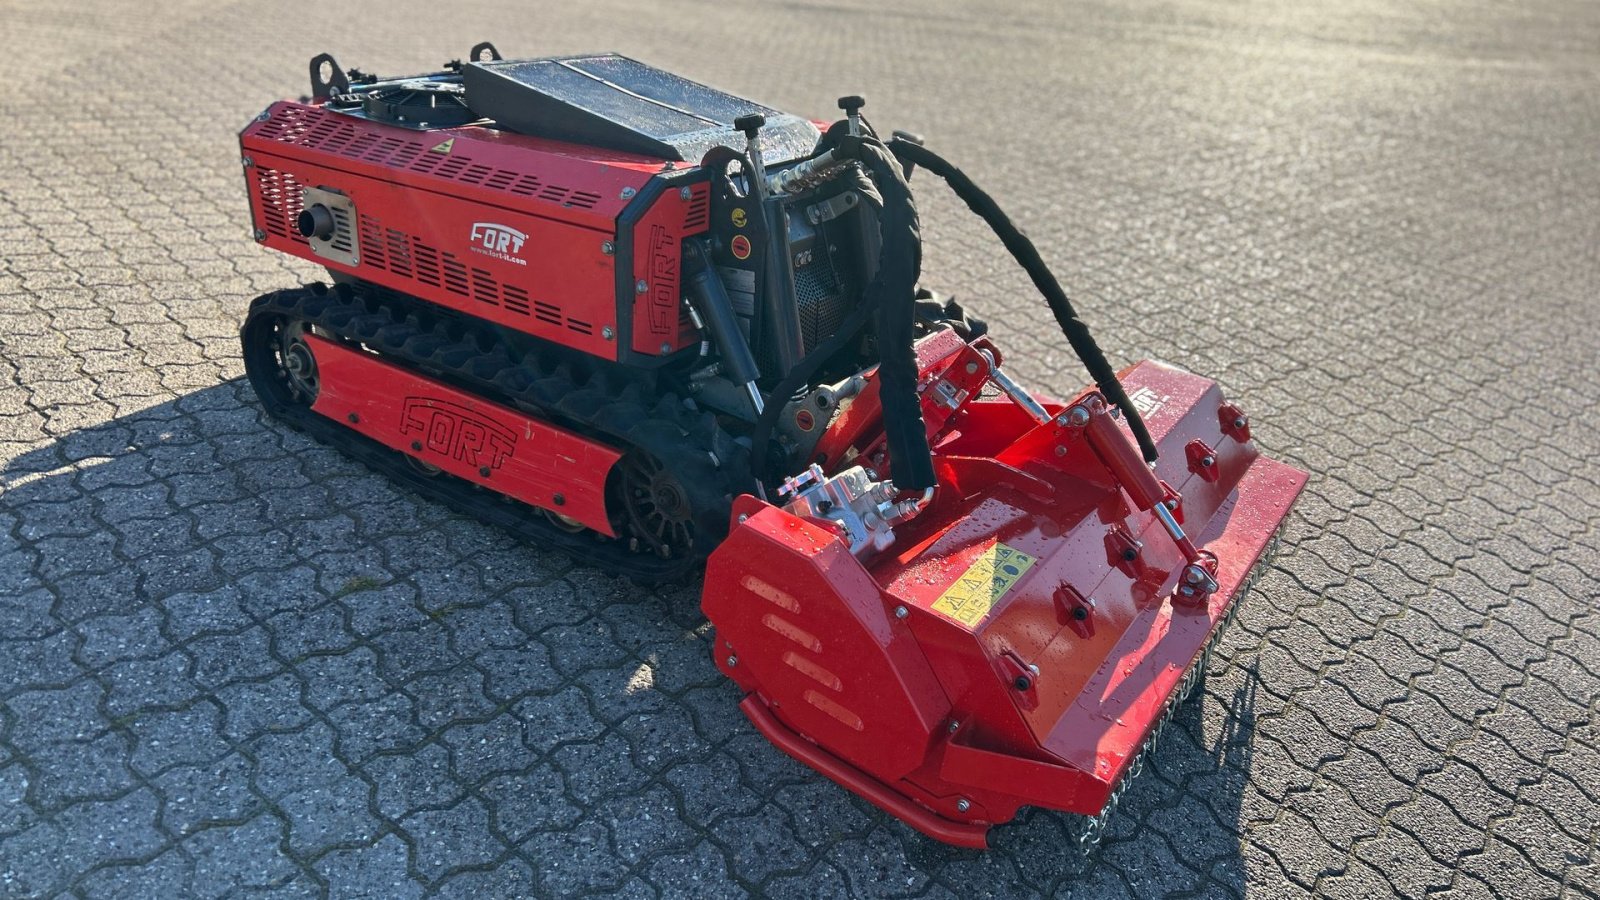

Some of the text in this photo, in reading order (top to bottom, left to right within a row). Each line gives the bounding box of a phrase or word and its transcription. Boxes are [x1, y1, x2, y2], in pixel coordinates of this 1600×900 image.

[470, 222, 526, 254] FORT
[470, 246, 527, 266] www.fort-it.com
[647, 224, 676, 335] FORT
[400, 396, 518, 469] FORT
